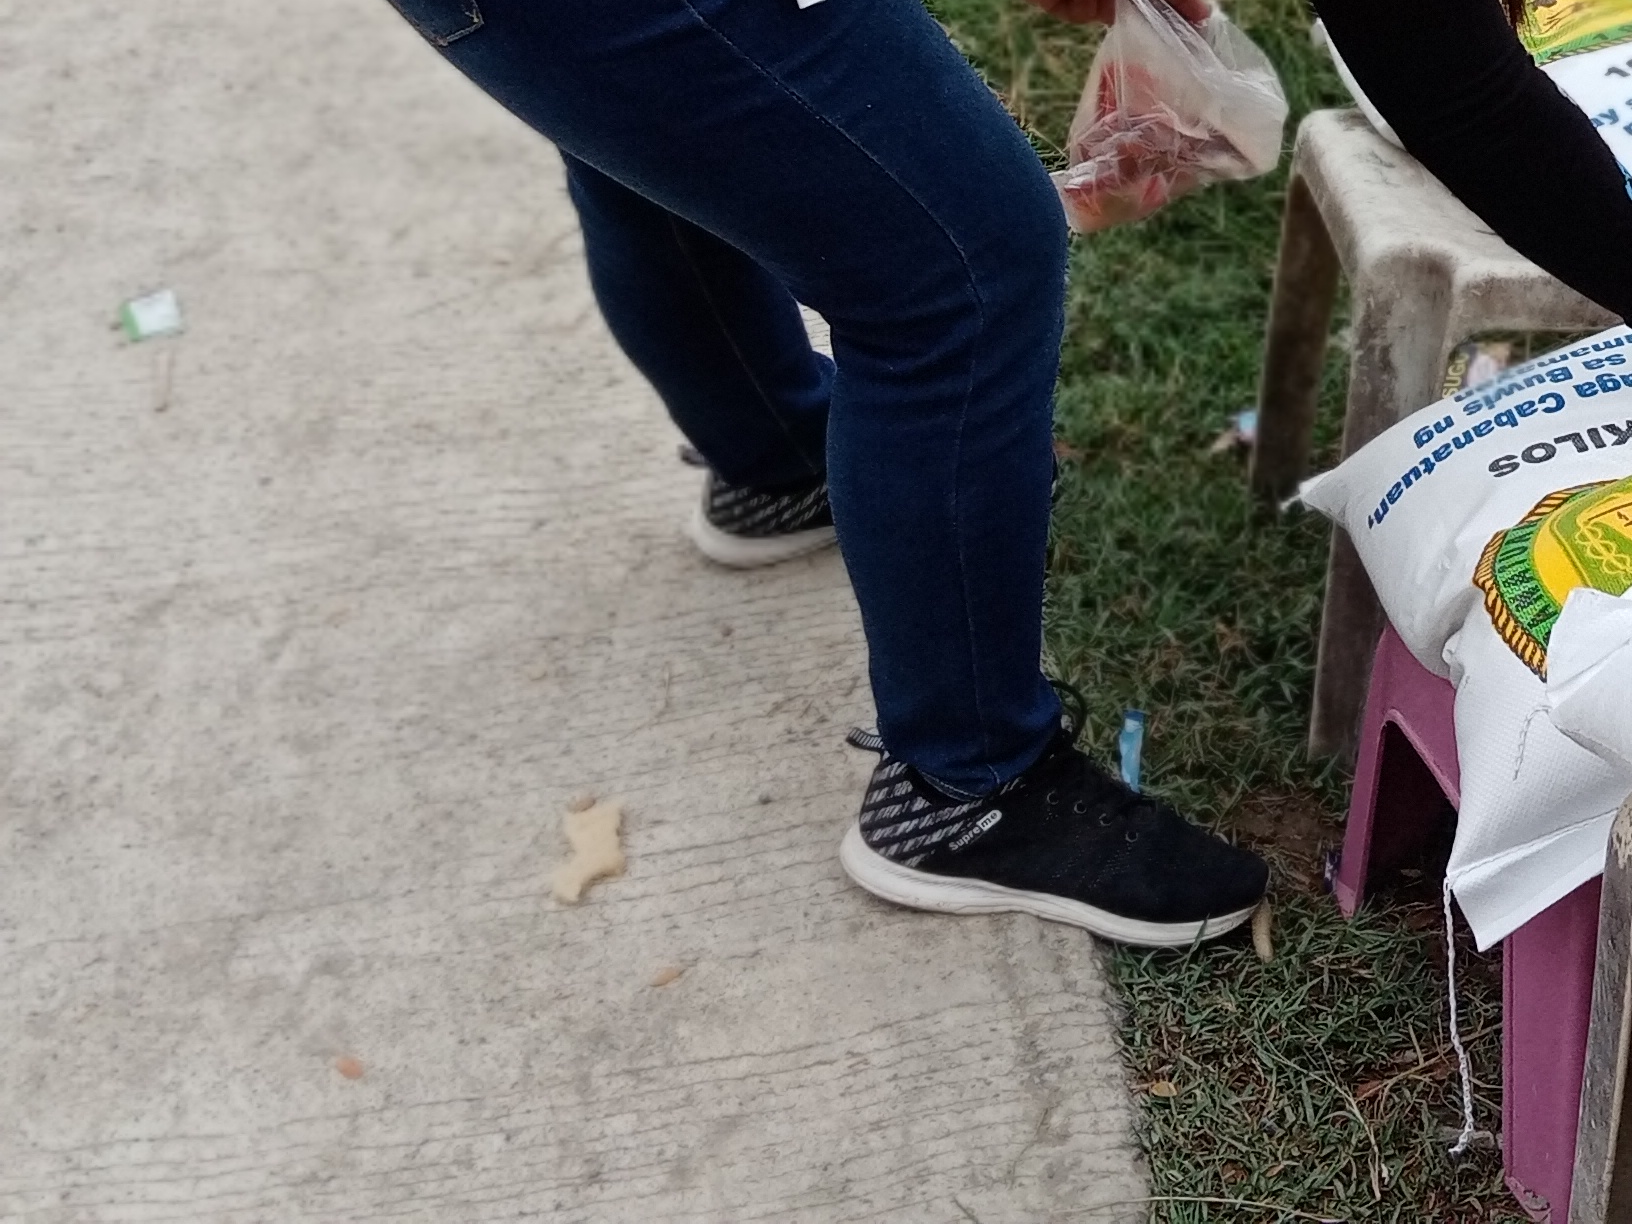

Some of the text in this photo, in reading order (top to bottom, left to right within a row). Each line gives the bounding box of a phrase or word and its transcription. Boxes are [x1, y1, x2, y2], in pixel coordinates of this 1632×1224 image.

[1588, 106, 1621, 128] ay
[1582, 352, 1628, 371] sa
[1462, 366, 1574, 416] Buwis
[1413, 414, 1456, 449] ng
[949, 812, 999, 851] Supreme
